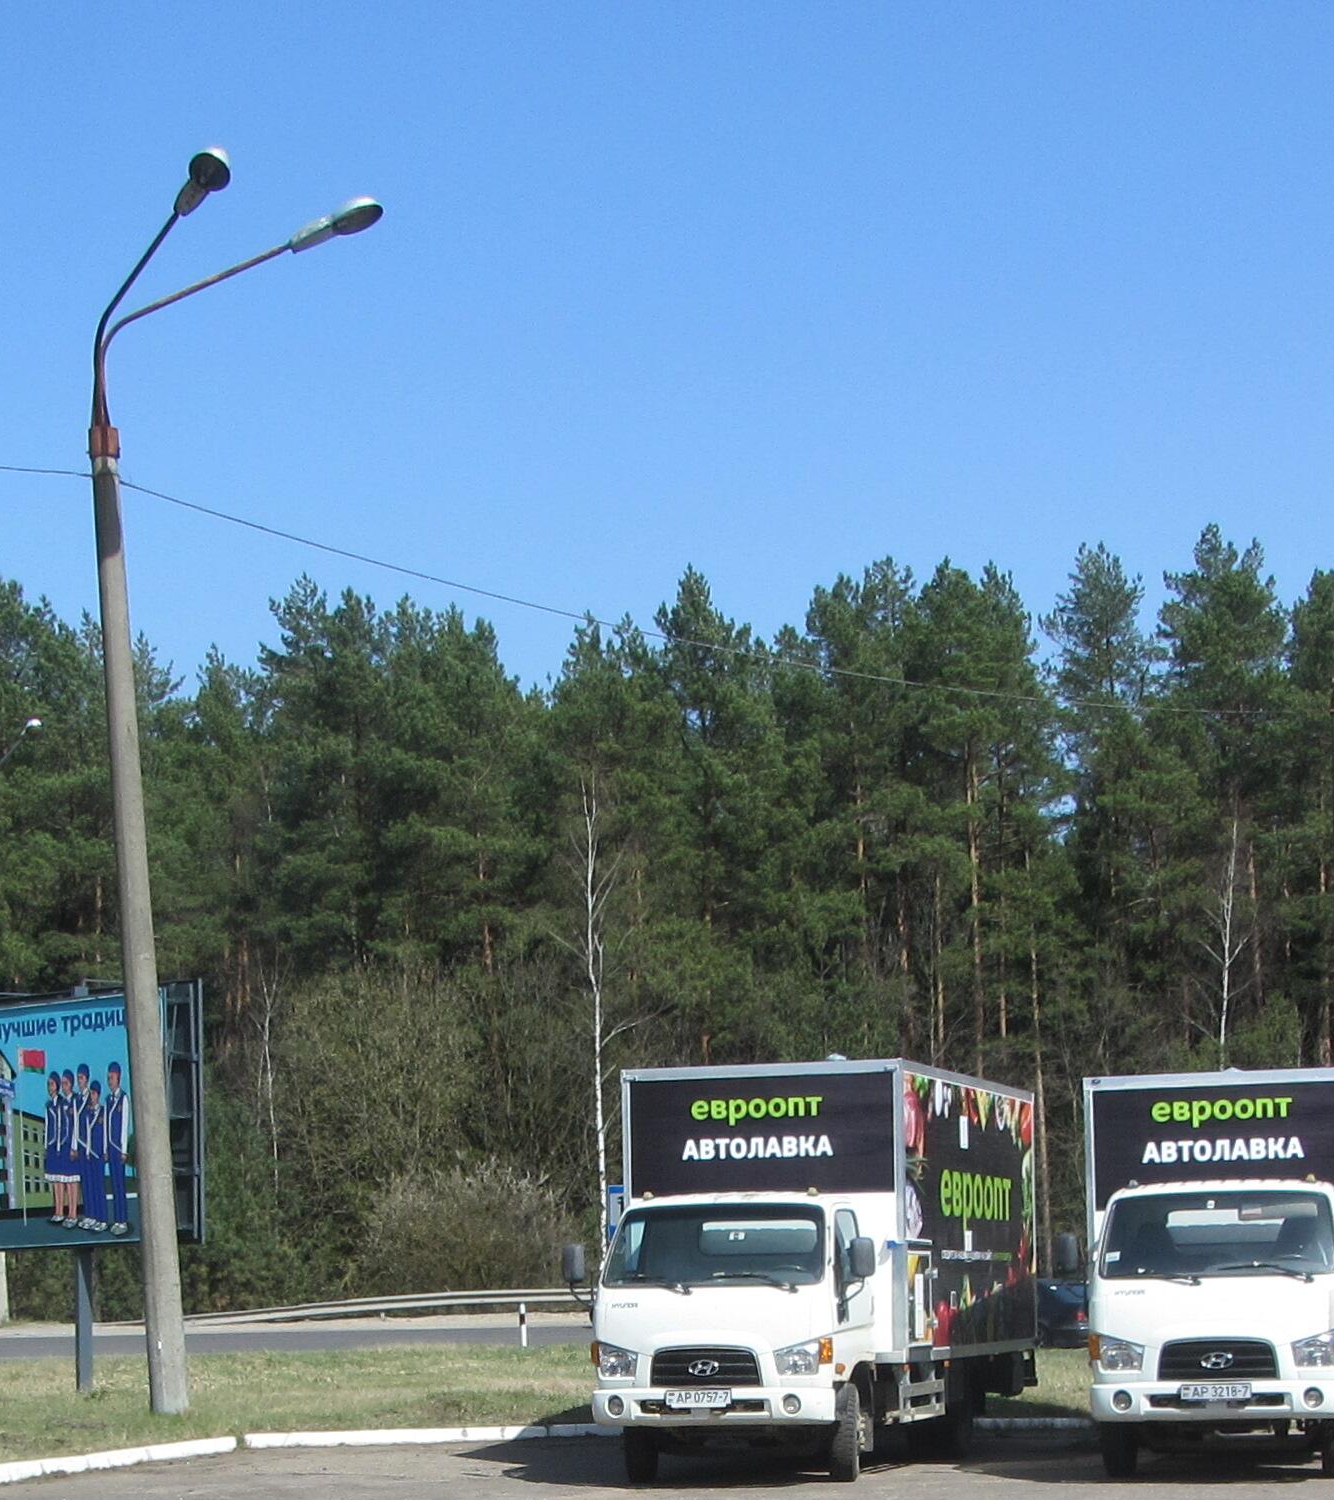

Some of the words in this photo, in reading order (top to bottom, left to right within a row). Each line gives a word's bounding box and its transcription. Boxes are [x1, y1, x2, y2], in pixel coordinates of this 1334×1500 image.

[690, 1096, 823, 1127] евроопт
[1150, 1097, 1293, 1128] евроопт
[681, 1134, 834, 1161] АВТОЛАВКА
[1141, 1136, 1305, 1164] АВТОЛАВКА
[940, 1168, 1012, 1231] евроопт
